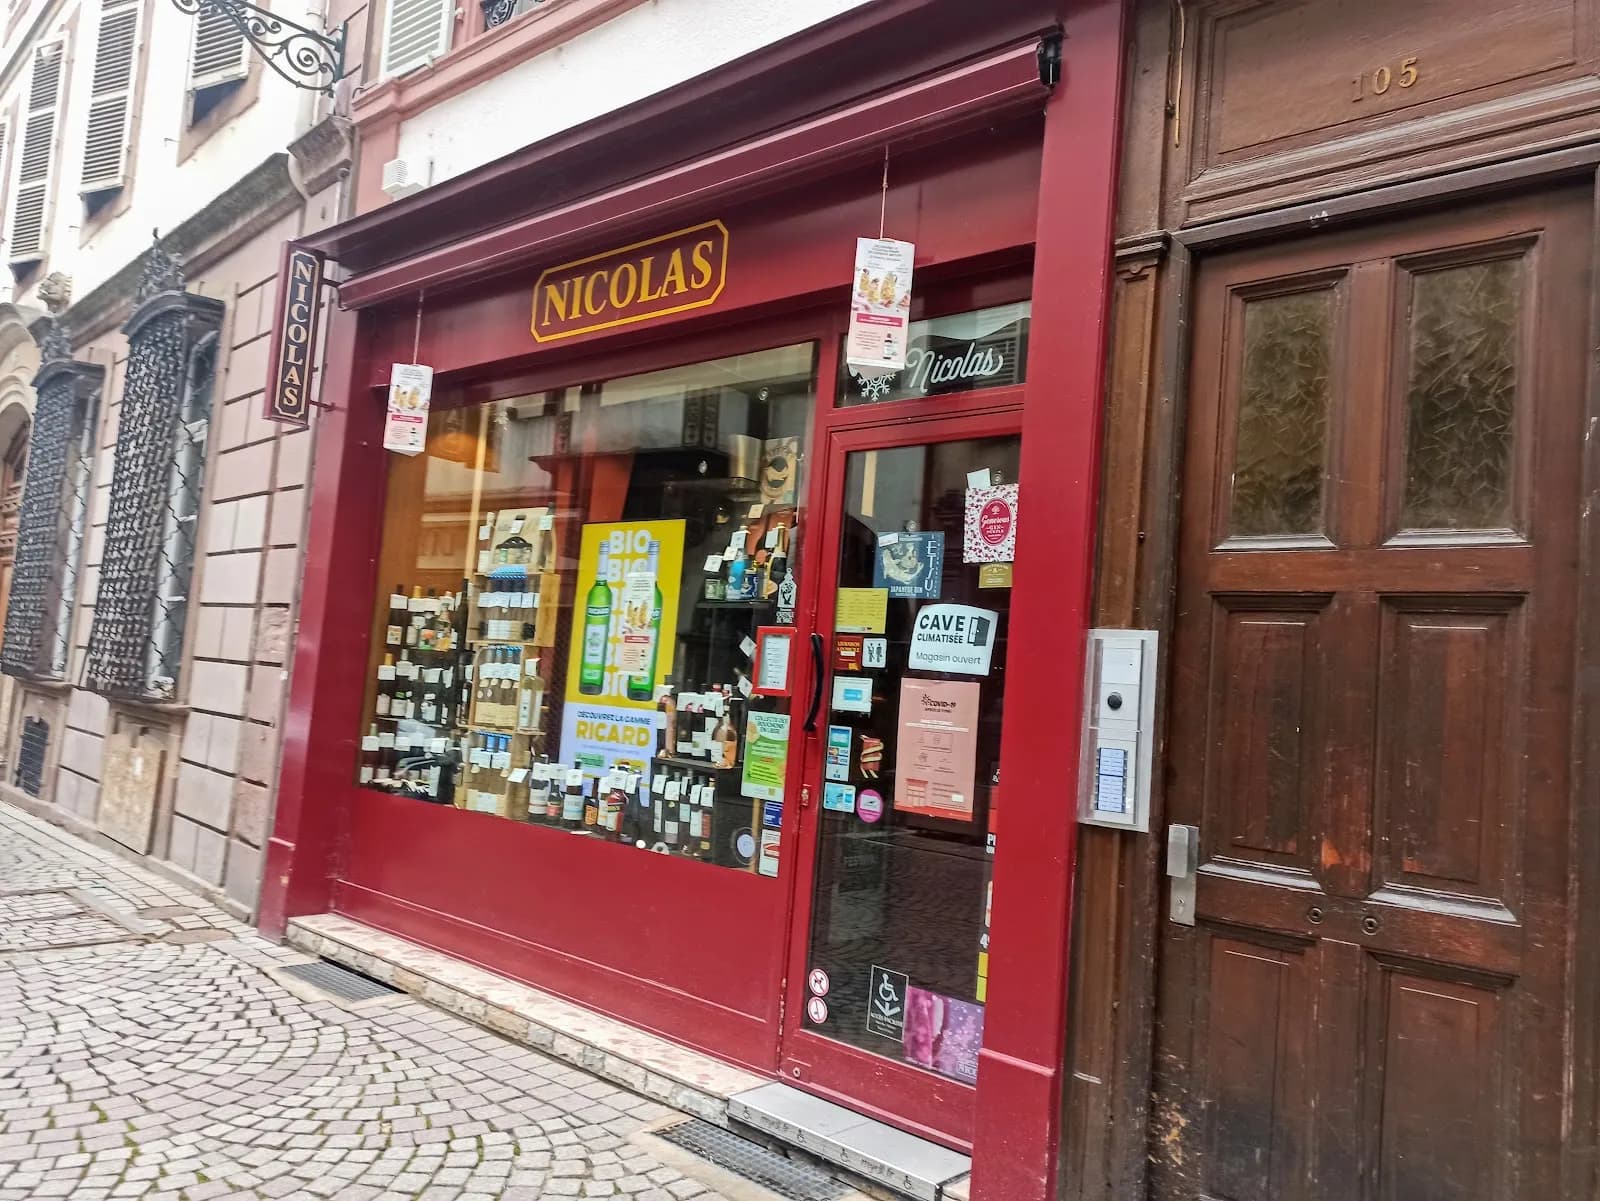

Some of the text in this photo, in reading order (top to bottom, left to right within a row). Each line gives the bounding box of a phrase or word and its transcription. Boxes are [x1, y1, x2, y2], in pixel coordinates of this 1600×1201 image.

[1352, 57, 1418, 103] 105
[541, 240, 713, 327] NICOLAS
[283, 260, 314, 407] NICOLAS
[905, 342, 1004, 394] Nicolas
[609, 529, 652, 554] BIO
[920, 614, 966, 632] CAVE
[917, 632, 965, 644] CLIMATISÉE
[916, 651, 981, 665] Magasin ouvert
[576, 720, 651, 748] RICARD
